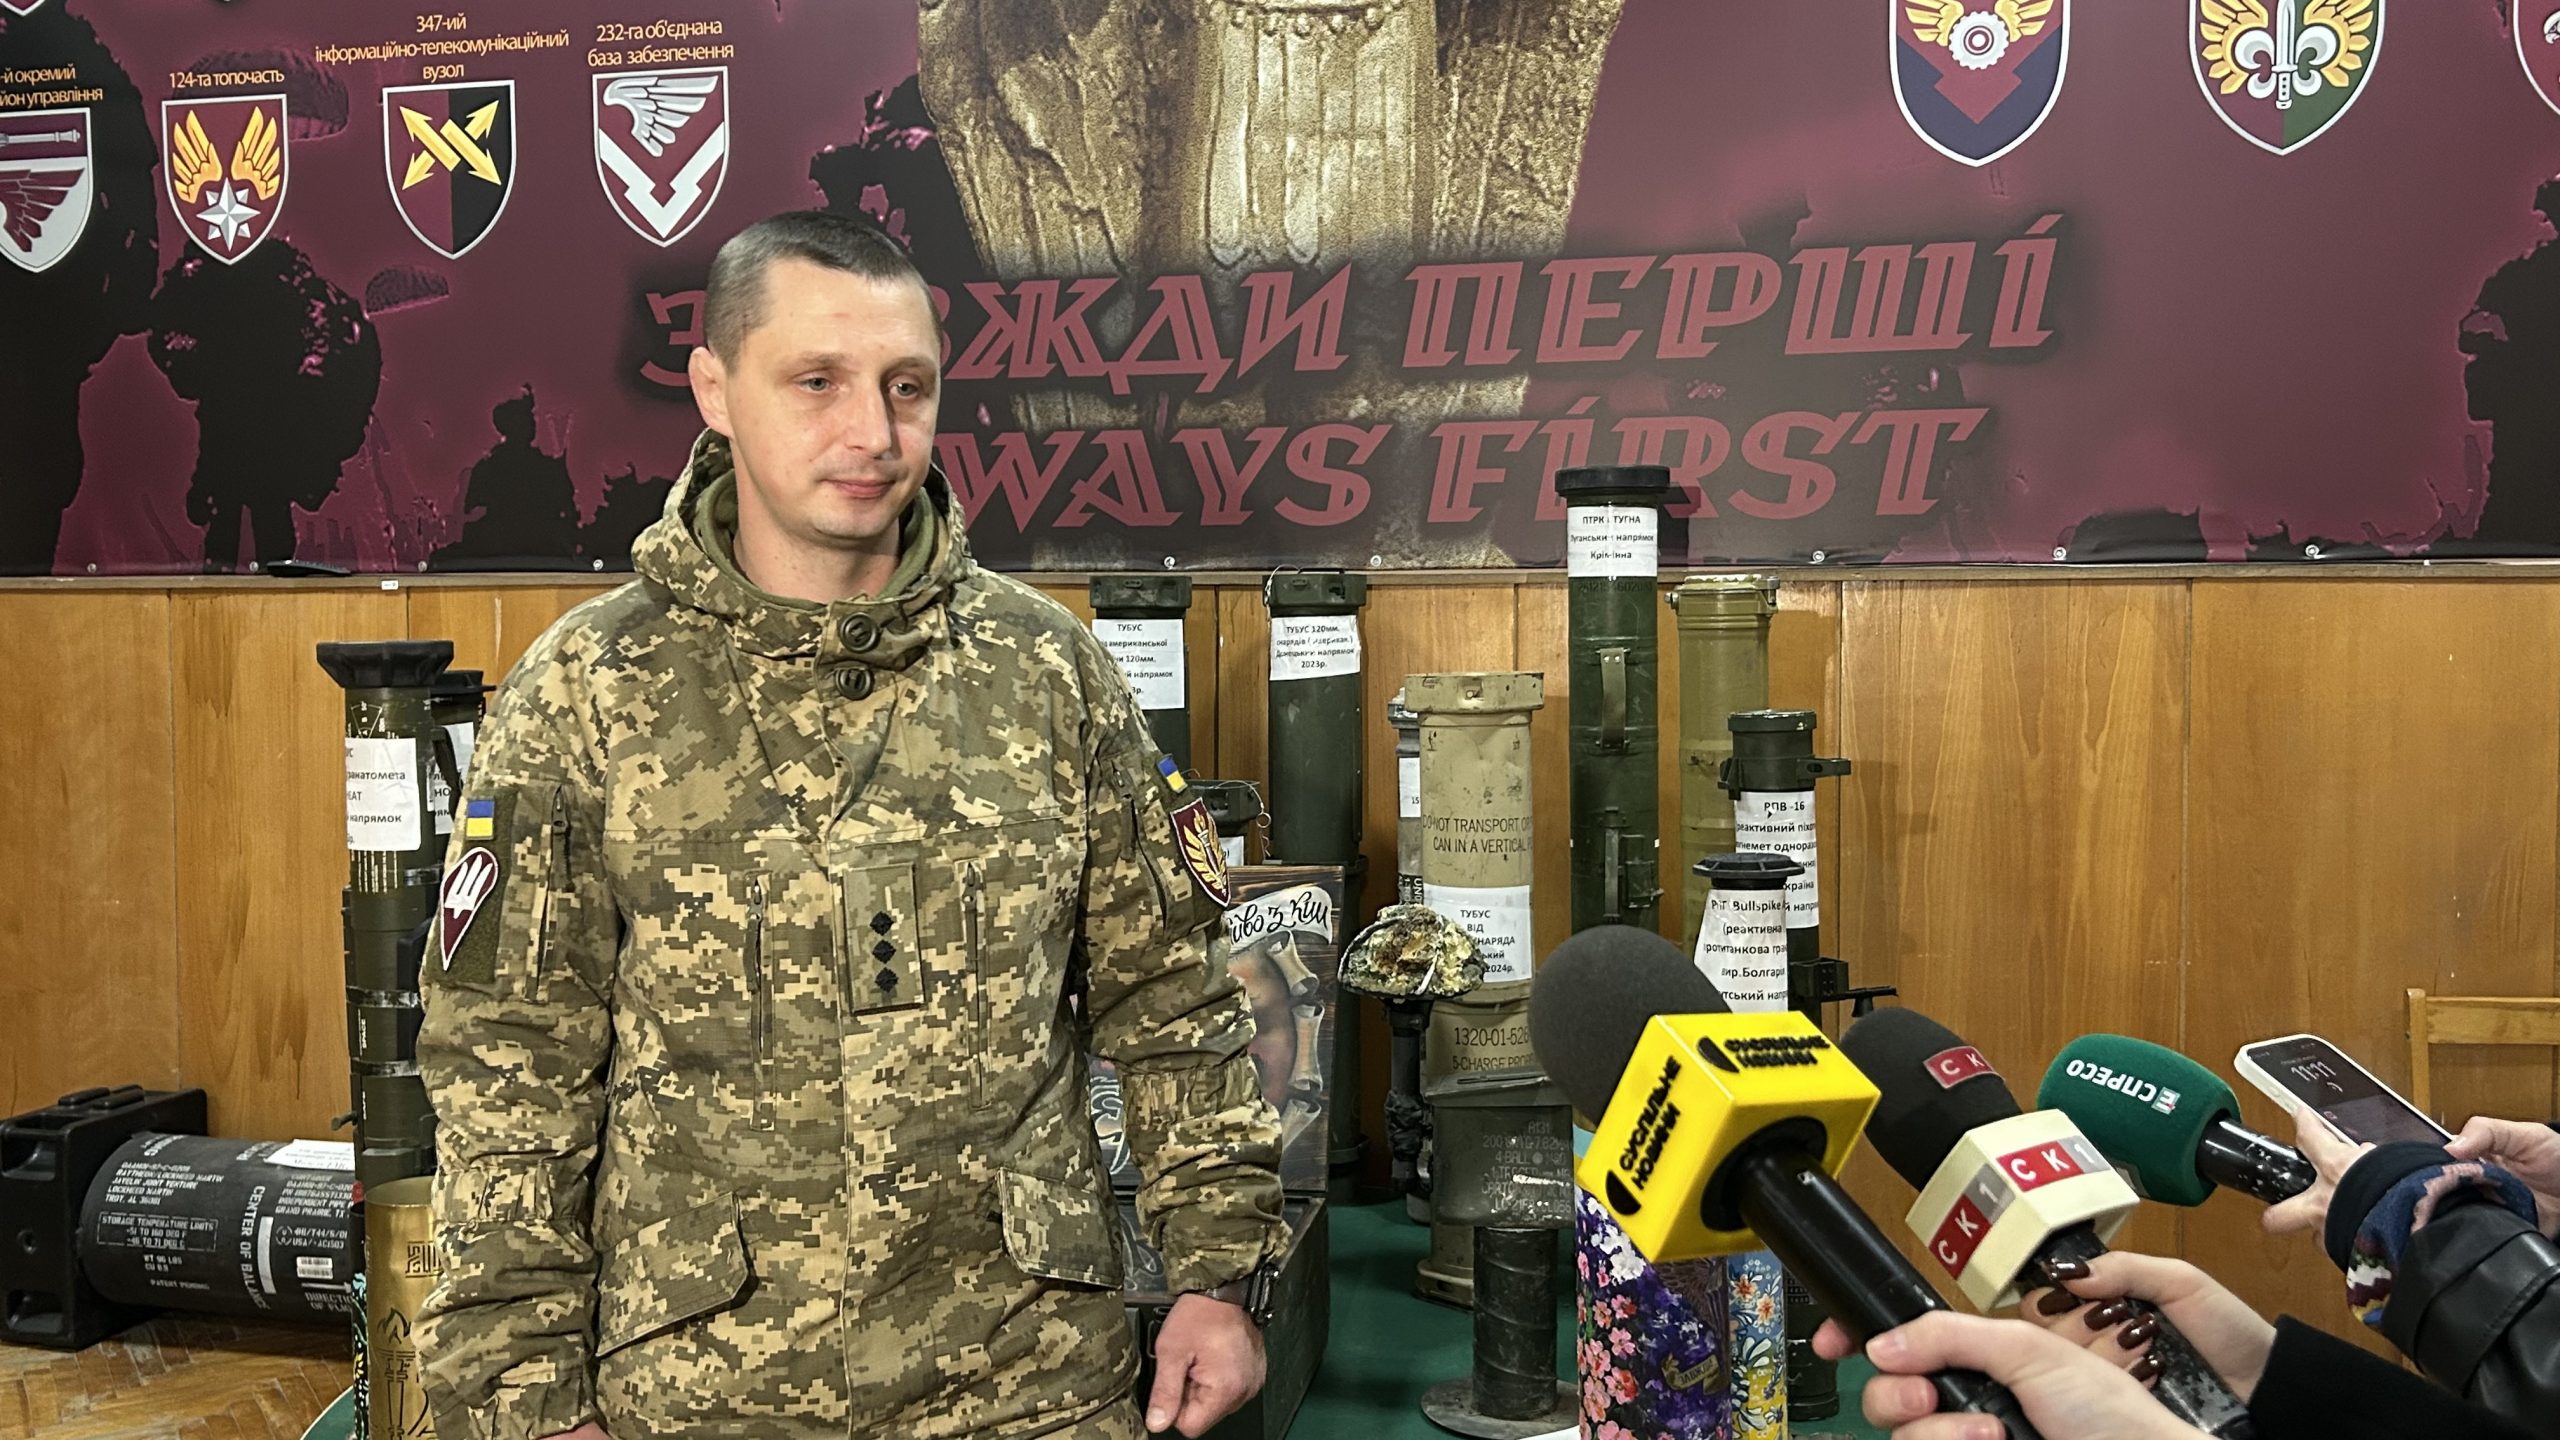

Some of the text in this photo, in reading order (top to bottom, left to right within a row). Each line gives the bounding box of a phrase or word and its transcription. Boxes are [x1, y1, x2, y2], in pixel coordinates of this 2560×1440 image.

[416, 13, 468, 33] 347-ий
[596, 19, 723, 42] 232-га об'єднана
[314, 30, 570, 66] інформаційно-телекомунікаційний
[587, 44, 735, 67] база забезпечення
[14, 63, 77, 86] окремий
[169, 68, 286, 89] 124-та топочасть
[423, 62, 465, 83] вузол
[26, 85, 104, 109] управління
[640, 262, 1352, 396] ЗЖДИ
[933, 423, 1394, 535] WAYS
[1582, 515, 1642, 525] ПТРК ТУГНА
[1570, 534, 1614, 544] Луганськи
[1117, 623, 1143, 632] ТУБУС
[1286, 625, 1310, 634] ТУБУС
[1134, 671, 1174, 680] напрямок
[1432, 817, 1450, 832] NOT
[1453, 818, 1520, 833] TRANSPORT
[1433, 836, 1452, 853] CAN
[1455, 838, 1467, 853] IN
[1469, 839, 1479, 853] A
[1480, 837, 1527, 854] VERTICAL
[1784, 880, 1814, 893] країна
[1461, 909, 1491, 918] ТУБУС
[1467, 924, 1484, 933] ВІД
[1722, 923, 1783, 935] (реактивна
[241, 1185, 267, 1237] CENTER
[102, 1216, 135, 1226] STORAGE
[137, 1217, 189, 1229] TEMPERATURE
[239, 1241, 252, 1259] OF
